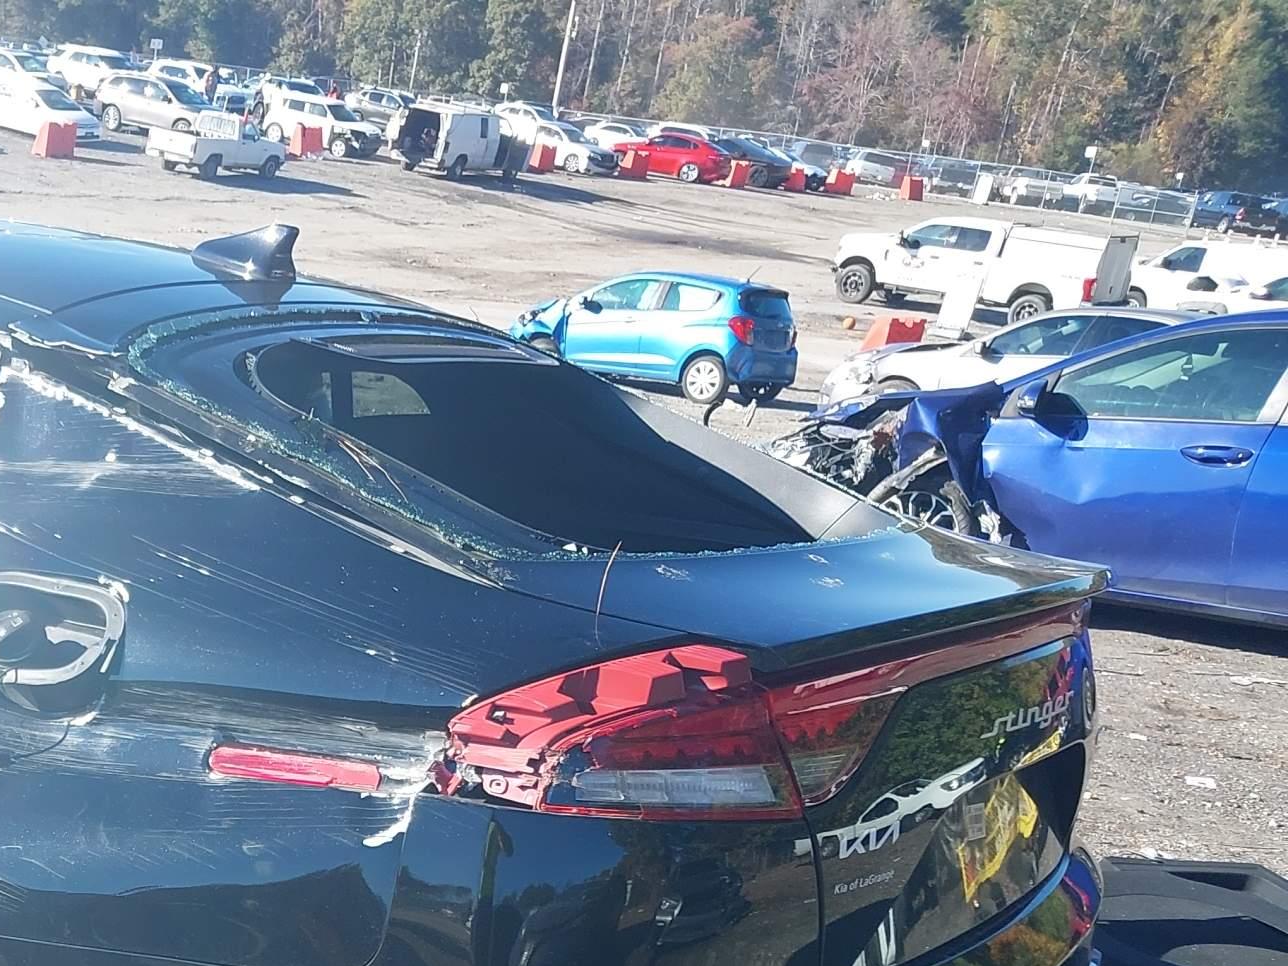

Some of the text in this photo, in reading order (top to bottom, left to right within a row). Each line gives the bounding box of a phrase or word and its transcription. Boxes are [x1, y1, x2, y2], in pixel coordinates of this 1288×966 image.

[839, 820, 901, 860] KIA
[834, 882, 848, 895] Kia
[849, 878, 859, 891] of
